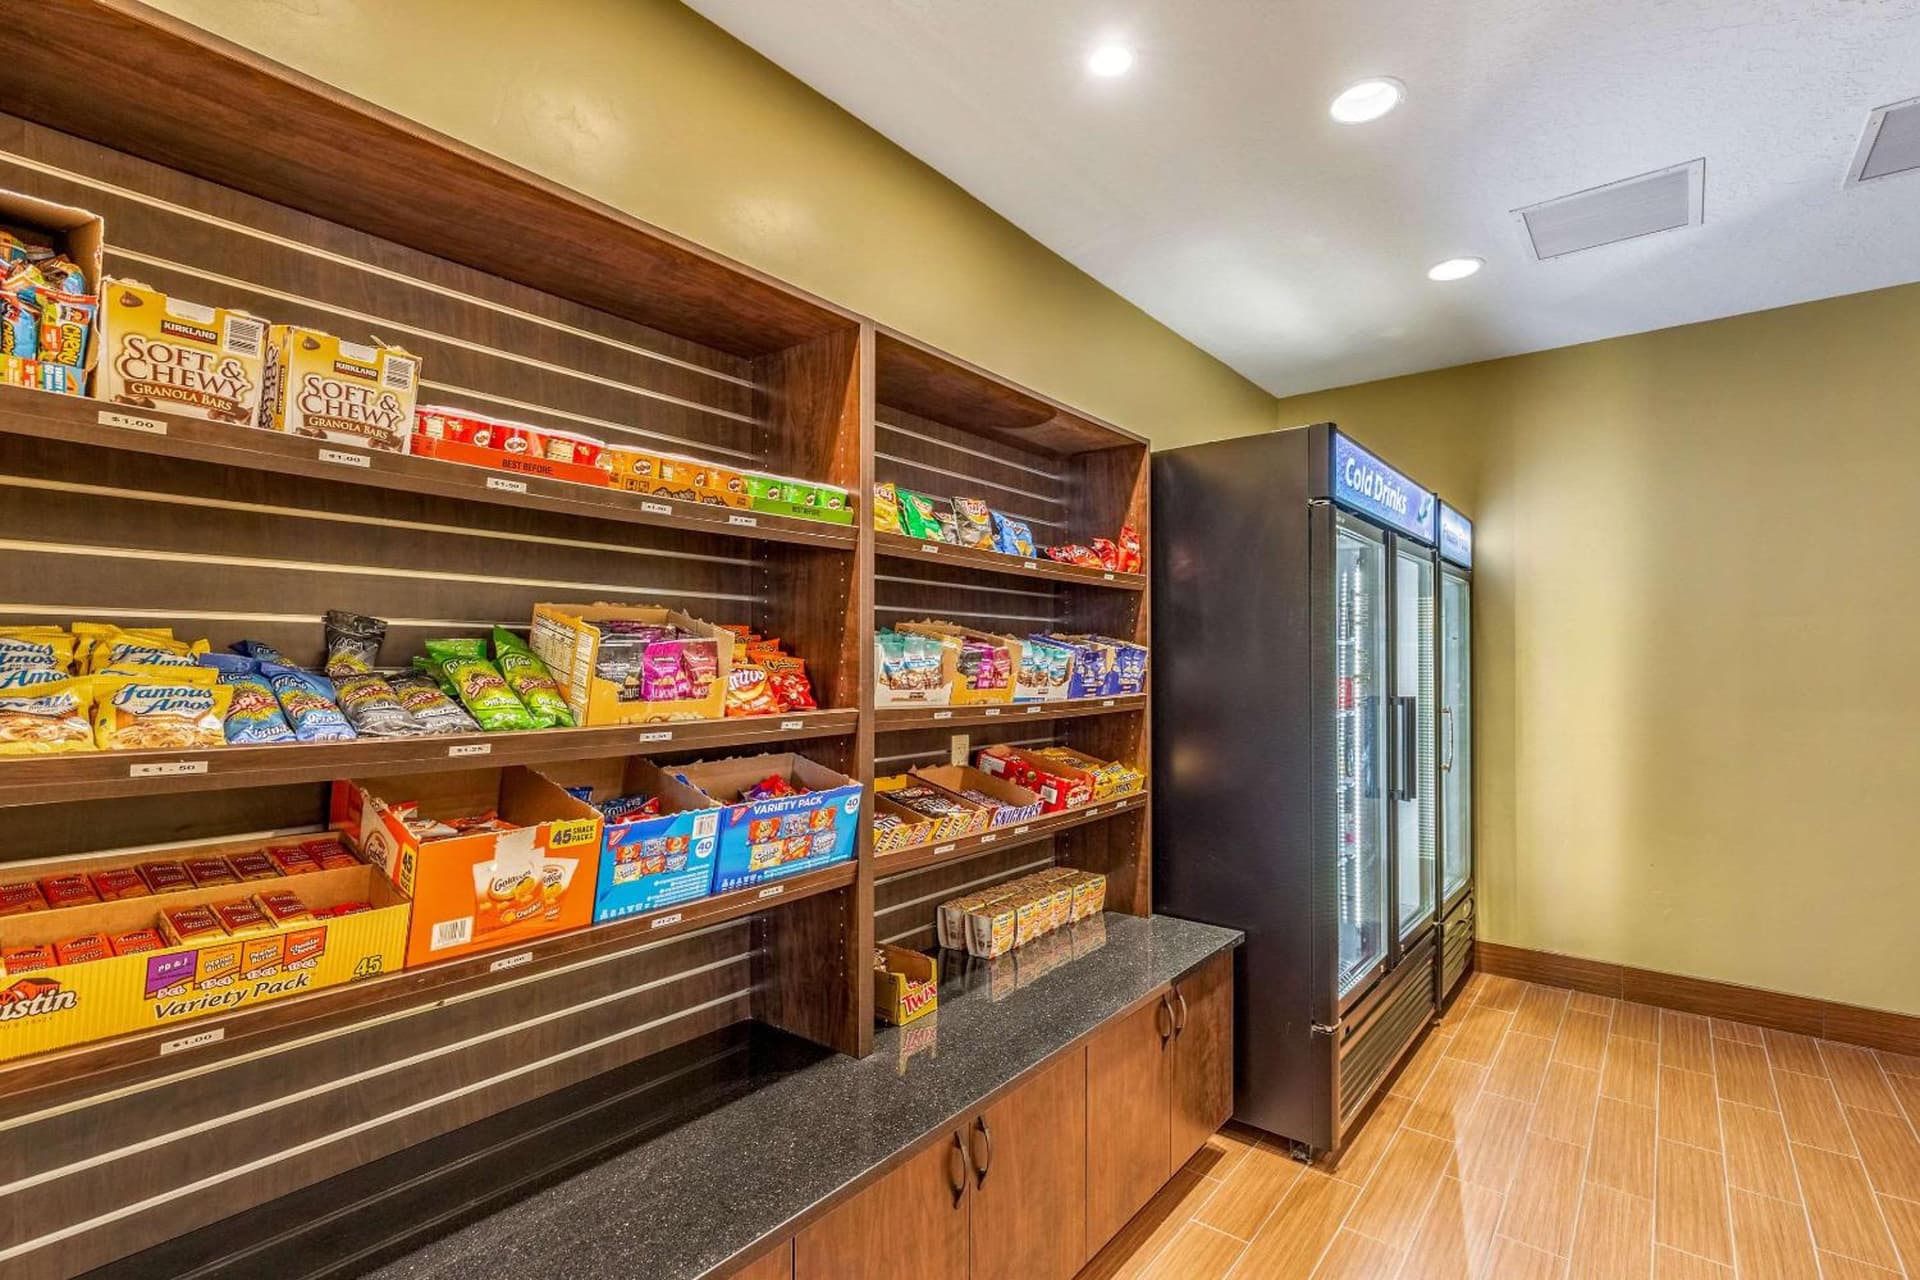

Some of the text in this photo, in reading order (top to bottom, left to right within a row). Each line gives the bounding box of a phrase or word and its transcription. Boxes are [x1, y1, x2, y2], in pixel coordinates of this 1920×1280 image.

[163, 322, 217, 341] KIRKLAND
[127, 337, 243, 382] SOFT &
[335, 362, 378, 377] KIRKLAND
[121, 358, 246, 399] CHEWY
[131, 383, 233, 411] GRANOLA BARS
[308, 376, 374, 405] SOFT
[380, 394, 397, 412] &
[301, 393, 400, 428] CHEWY
[111, 416, 155, 429] $1.00
[309, 416, 389, 440] GRANOLA BARS
[502, 458, 521, 469] BEST
[1344, 457, 1408, 515] Cold Drinks
[111, 683, 213, 705] Famous
[135, 699, 212, 715] Amos
[754, 796, 823, 815] VARIETY PACK
[847, 798, 859, 808] 40
[552, 829, 572, 845] 45
[697, 841, 712, 851] 40
[353, 955, 382, 976] 45
[0, 990, 76, 1021] ustin
[155, 973, 309, 1019] Variety Pack
[901, 982, 937, 1016] Twix
[172, 1033, 213, 1048] $1.00
